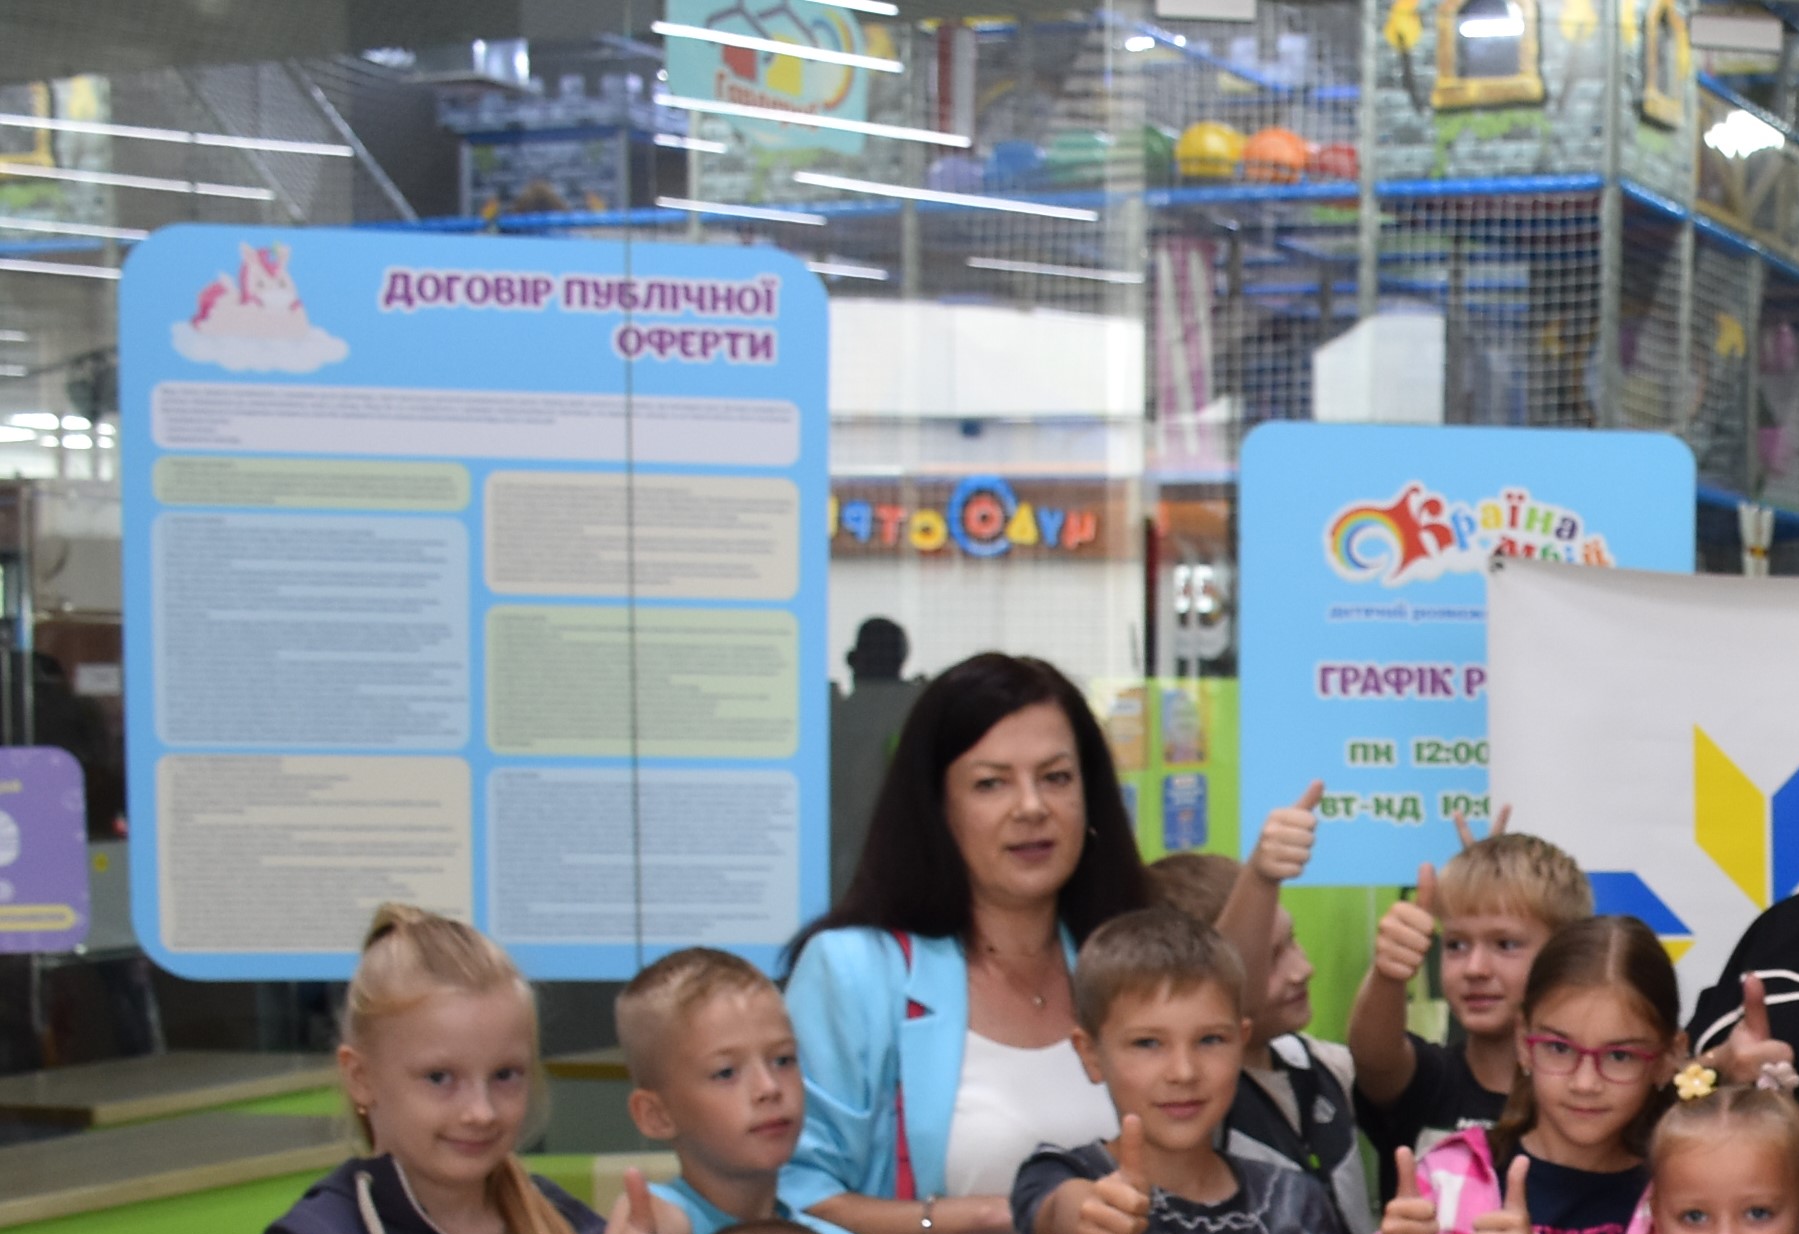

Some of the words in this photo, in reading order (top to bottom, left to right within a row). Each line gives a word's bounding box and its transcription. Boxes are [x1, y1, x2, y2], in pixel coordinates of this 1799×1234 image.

[382, 271, 552, 308] ДОГОВІР
[563, 276, 777, 315] ПУБЛІЧНОЇ
[617, 326, 775, 360] ОФЕРТИ
[1318, 664, 1454, 697] ГРАФІК
